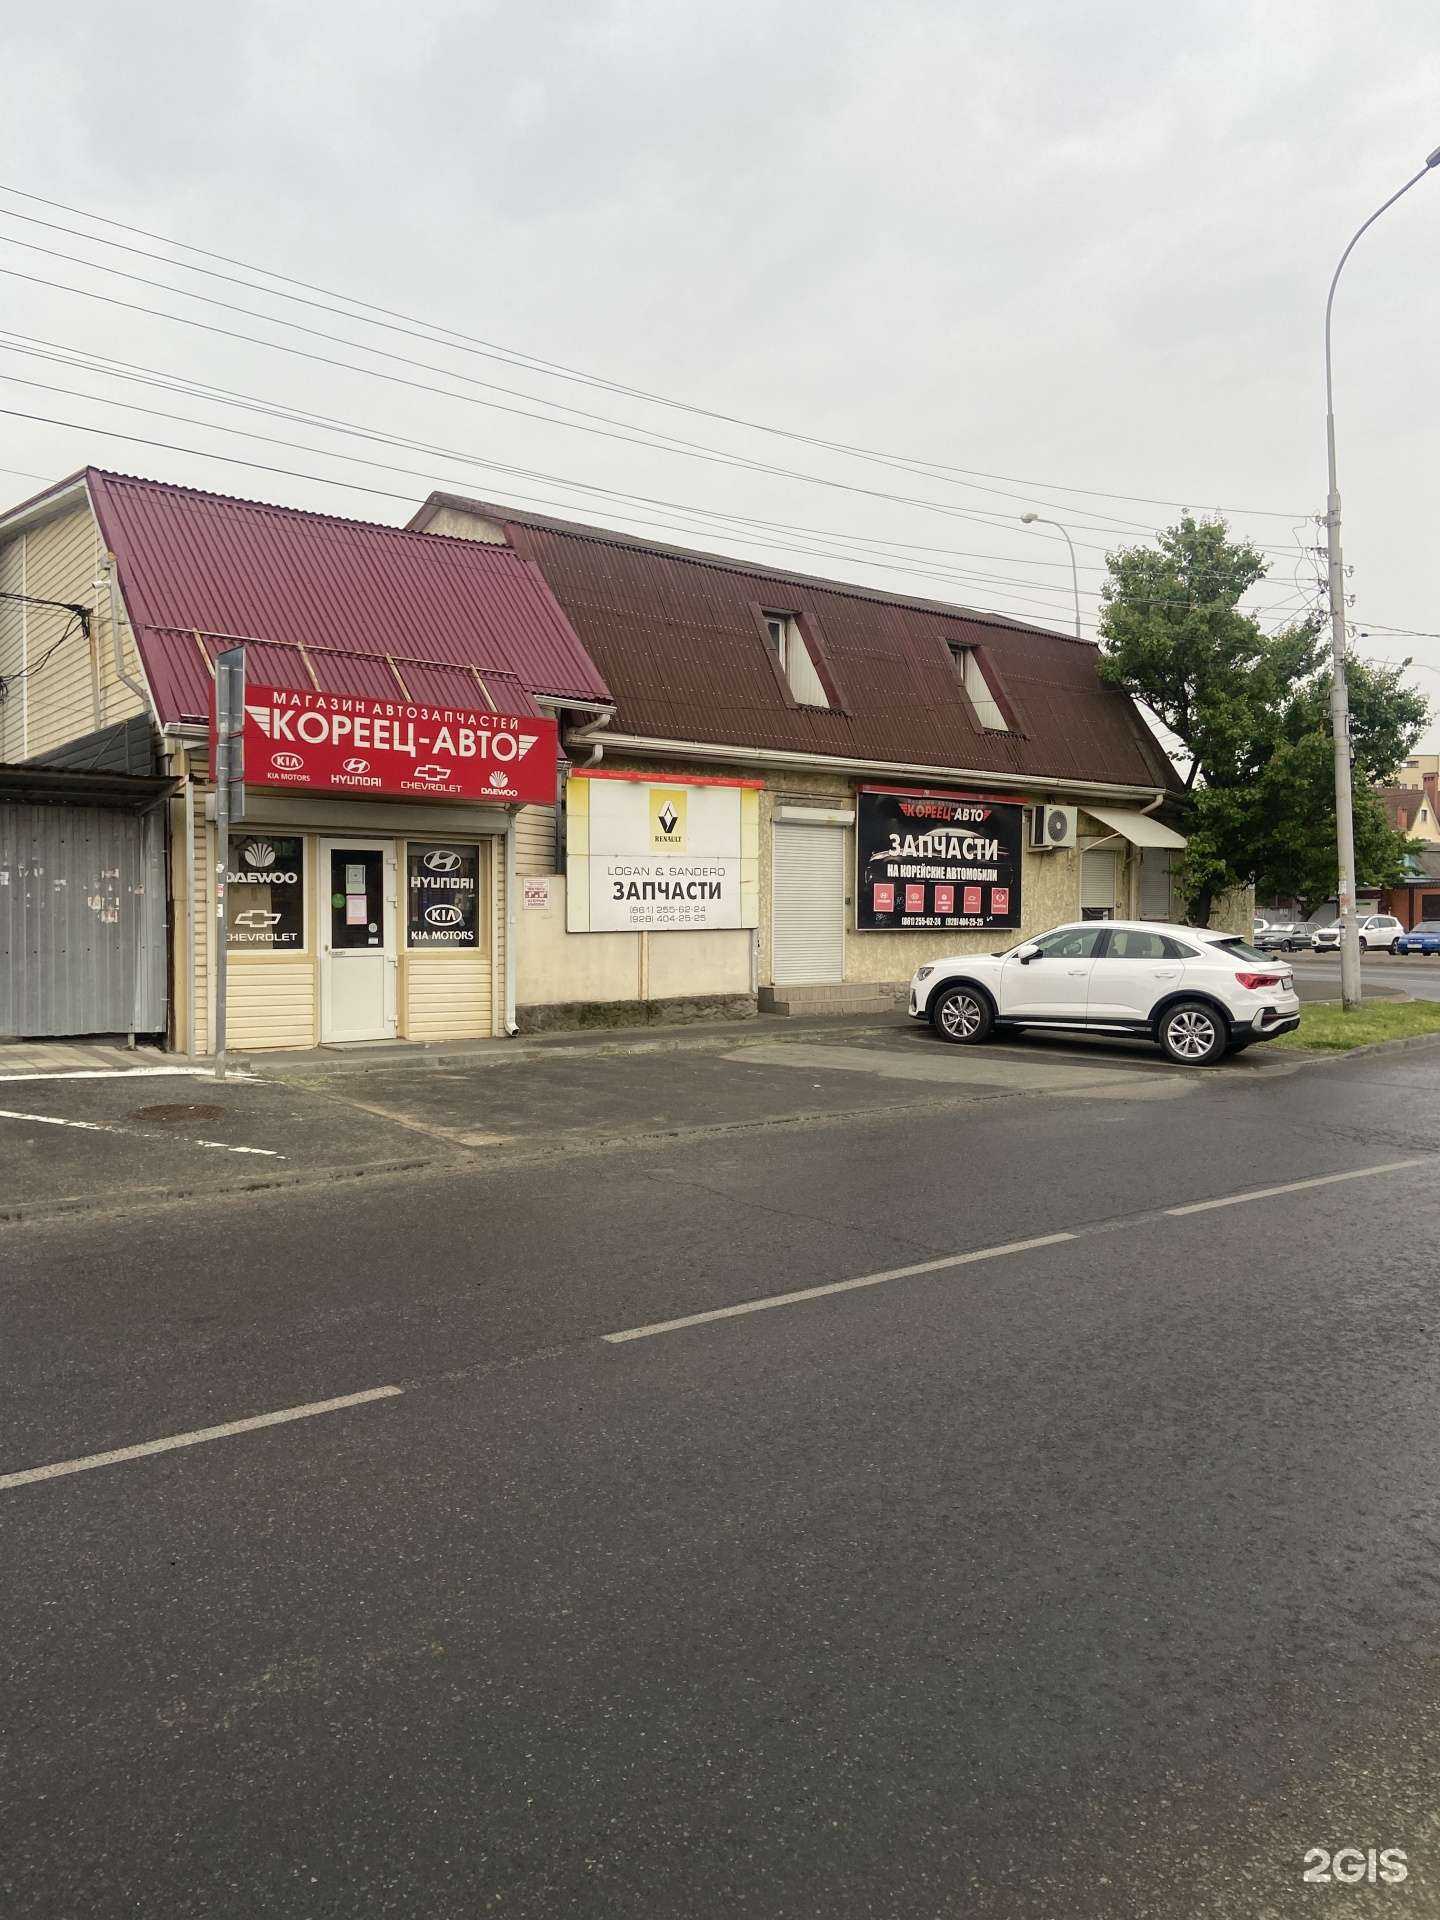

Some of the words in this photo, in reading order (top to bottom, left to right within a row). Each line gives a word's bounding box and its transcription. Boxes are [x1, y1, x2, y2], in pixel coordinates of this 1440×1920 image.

[273, 691, 365, 713] МАГАЗИН
[373, 702, 519, 730] АВТОЗАПЧАСТЕЙ
[273, 708, 518, 762] КОРЕЕЦ-АВТО
[267, 771, 280, 780] KIA
[281, 772, 311, 782] MOTORS
[330, 774, 382, 787] HYUNDAI
[400, 781, 462, 793] CHEVROLET
[480, 787, 518, 797] DAEWOO
[906, 803, 984, 822] КОРЕЕЦ-АВТО
[888, 833, 998, 861] ЗАПЧАСТИ
[607, 866, 650, 876] LOGAN
[655, 867, 664, 876] &
[668, 867, 726, 877] SANDERO
[887, 864, 900, 877] НА
[900, 863, 945, 879] КОРЕЙСКИЕ
[946, 866, 998, 881] АВТОМОБИЛИ
[226, 872, 298, 884] DAEWOO
[410, 876, 474, 889] HYUNDAI
[612, 881, 722, 900] ЗАПЧАСТИ
[431, 909, 456, 921] KIA
[630, 906, 653, 914] (861)
[656, 905, 706, 913] 255-62-24
[656, 914, 706, 922] 404-25-25
[411, 931, 429, 940] KIA
[431, 930, 474, 940] MOTORS
